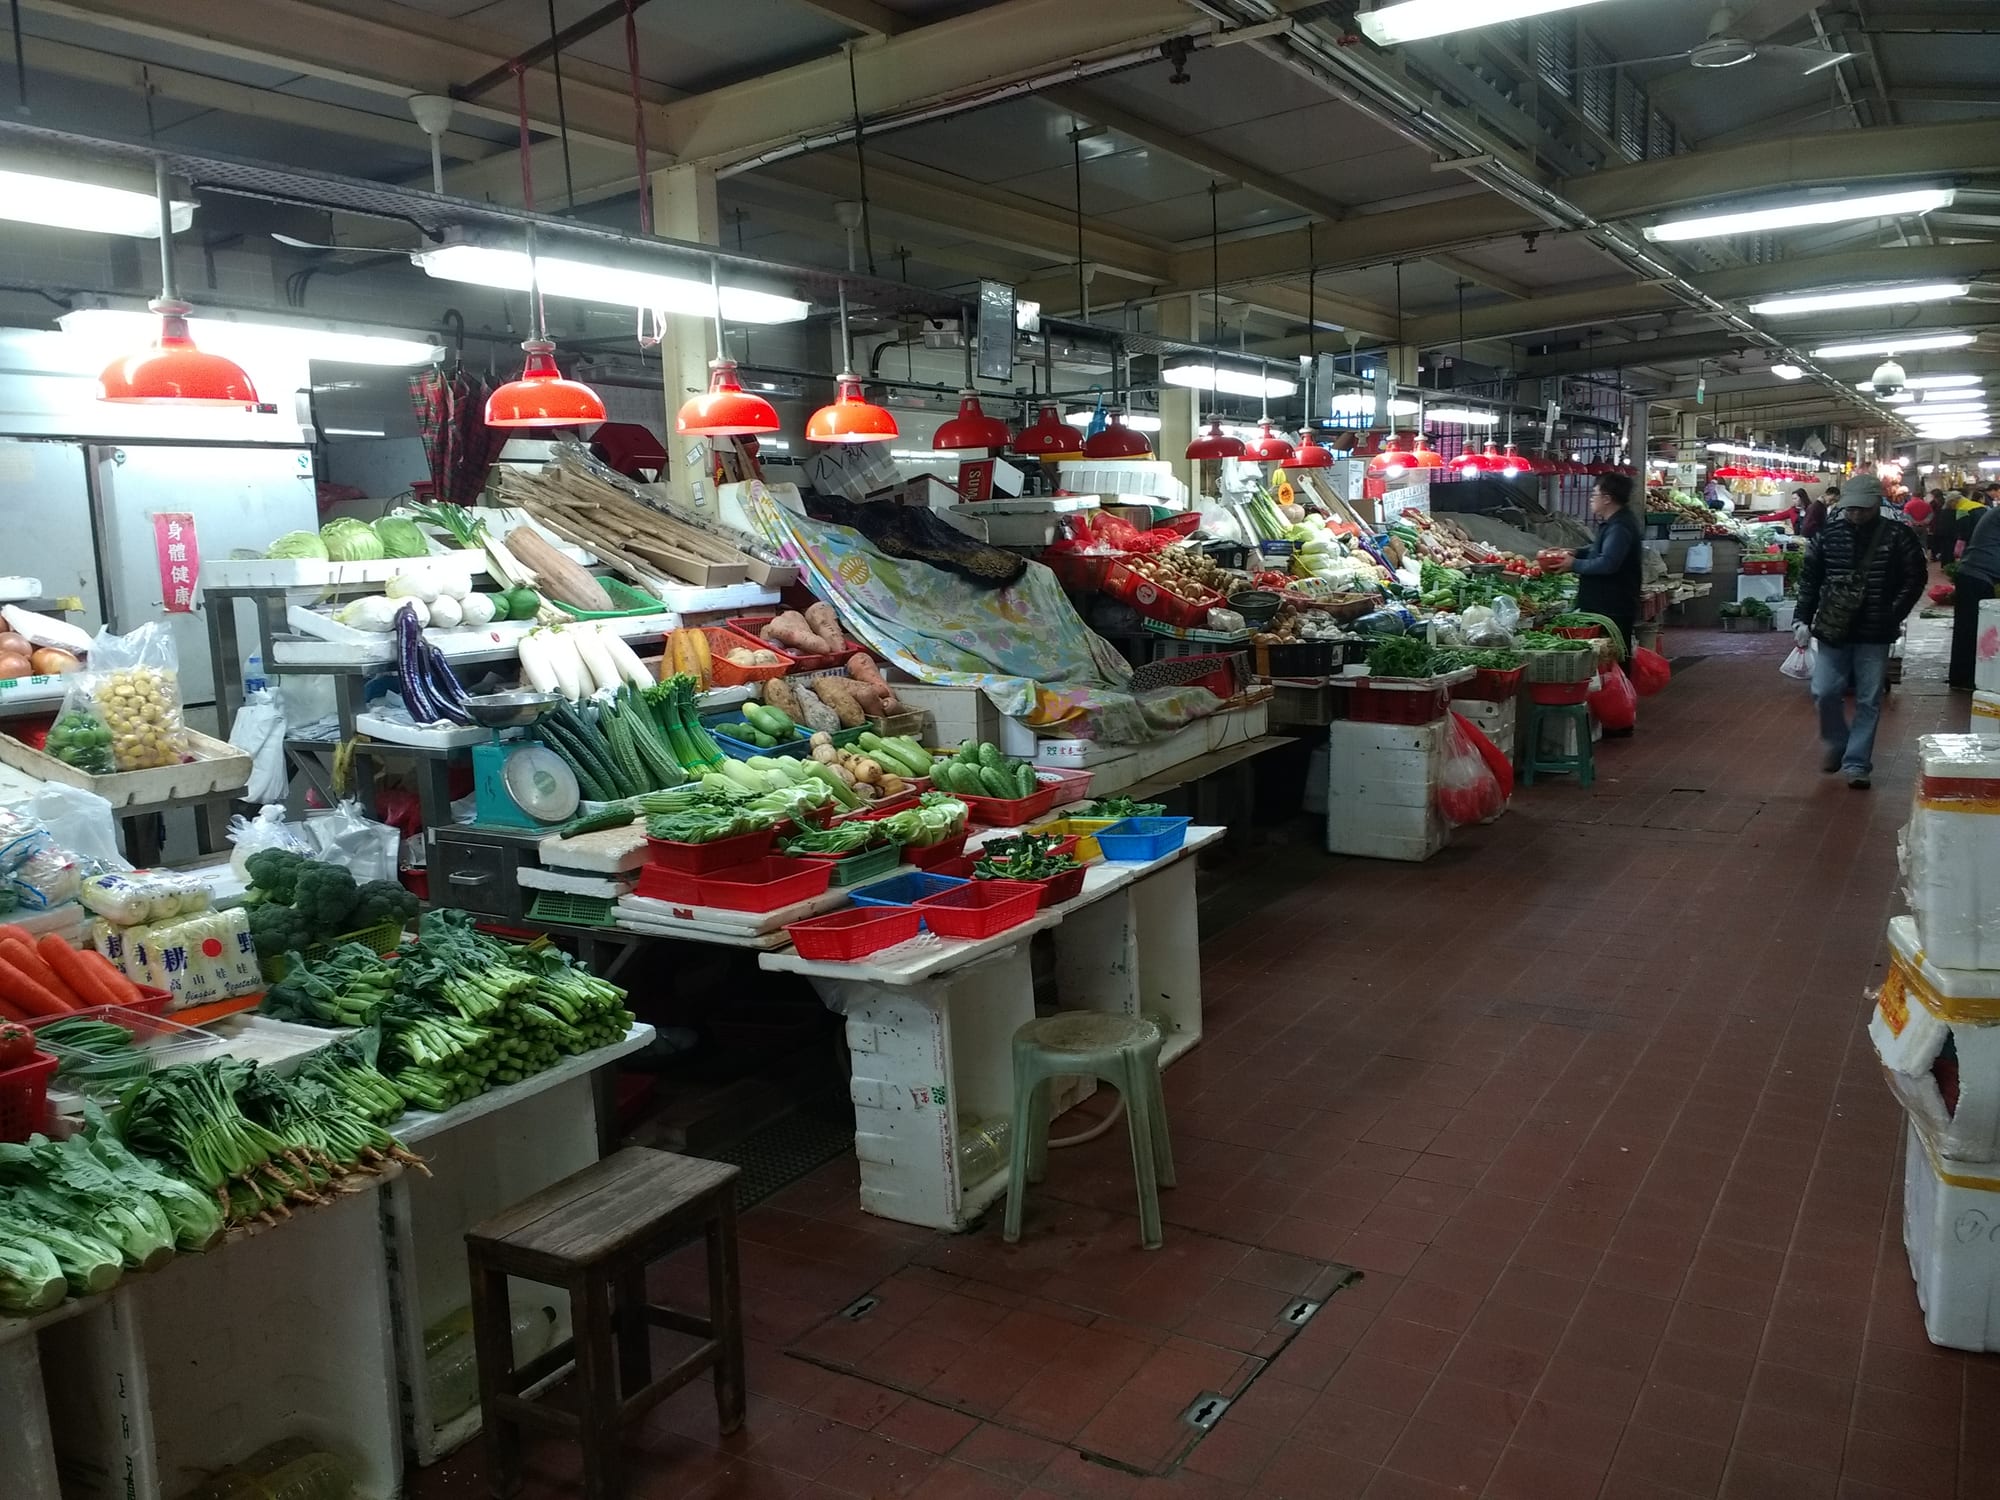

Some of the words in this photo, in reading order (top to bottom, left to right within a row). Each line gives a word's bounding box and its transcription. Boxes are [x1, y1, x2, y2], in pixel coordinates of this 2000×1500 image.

[1681, 465, 1692, 474] 14
[167, 520, 190, 605] 身體健康
[162, 946, 188, 973] 耕
